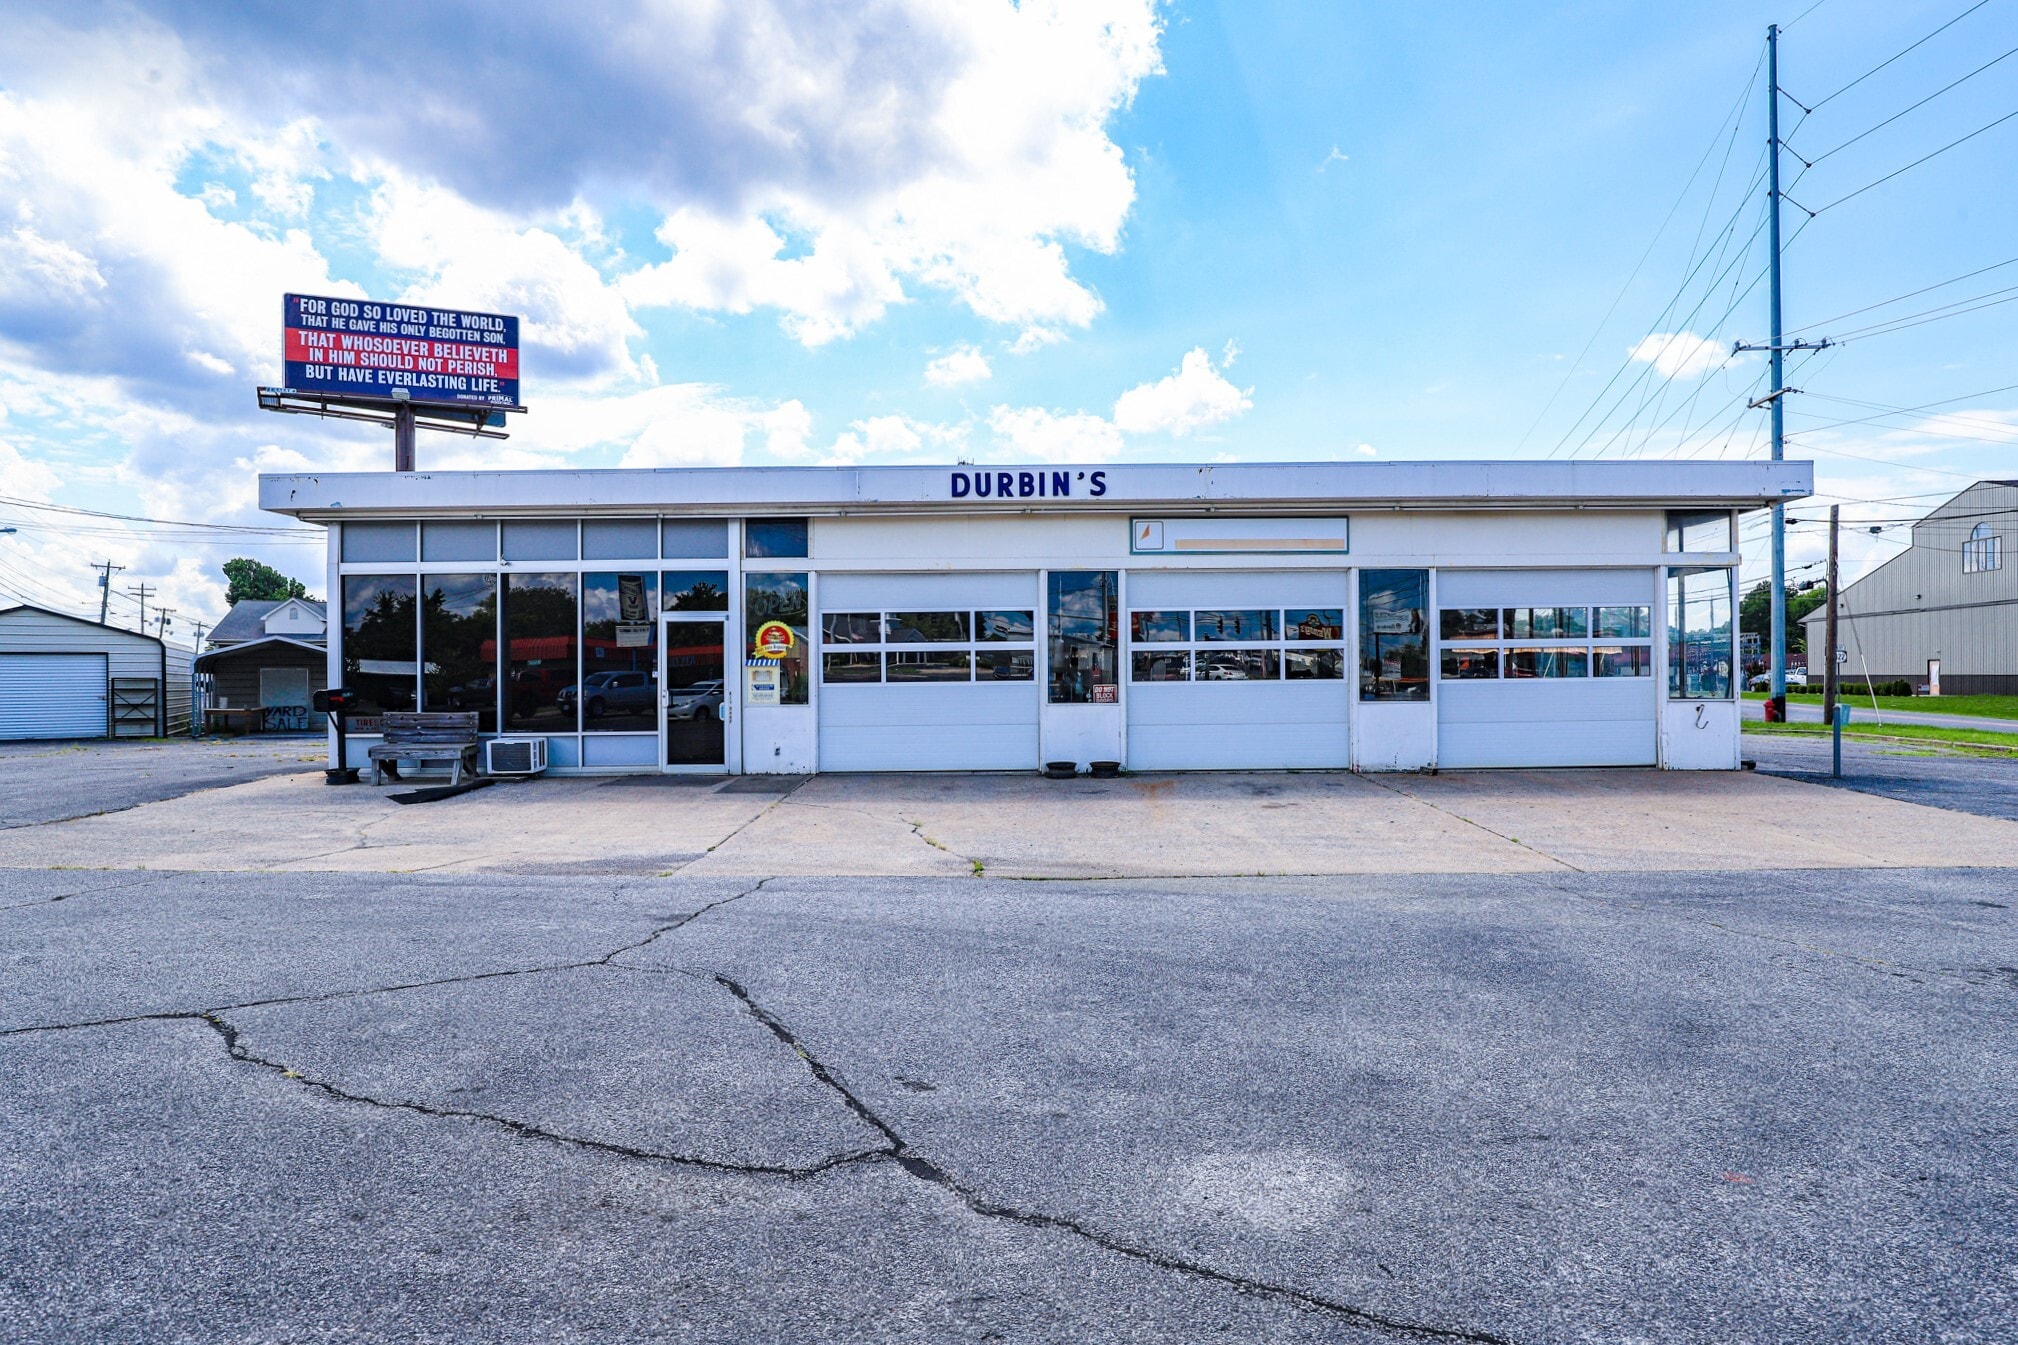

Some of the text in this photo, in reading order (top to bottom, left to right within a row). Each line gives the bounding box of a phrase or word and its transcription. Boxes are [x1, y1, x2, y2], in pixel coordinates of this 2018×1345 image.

[301, 314, 506, 345] THAT HE GAVE HIS ONLY BEGOTTEN SON,
[331, 301, 359, 317] GOD
[363, 305, 381, 320] SO
[386, 307, 427, 324] LOVED
[431, 311, 457, 327] THE
[460, 314, 506, 333] WORLD,
[298, 330, 508, 363] THAT WHOSOEVER BELIEVETH
[309, 347, 498, 377] IN HIM SHOULD NOT PERISH,
[305, 364, 333, 380] BUT
[338, 367, 373, 383] HAVE
[378, 370, 467, 391] EVERLASTING
[487, 394, 514, 403] PRIMAL
[951, 471, 1107, 498] DURBIN'S
[754, 589, 801, 616] OPEN
[264, 716, 308, 731] SALE
[266, 705, 307, 717] YARD
